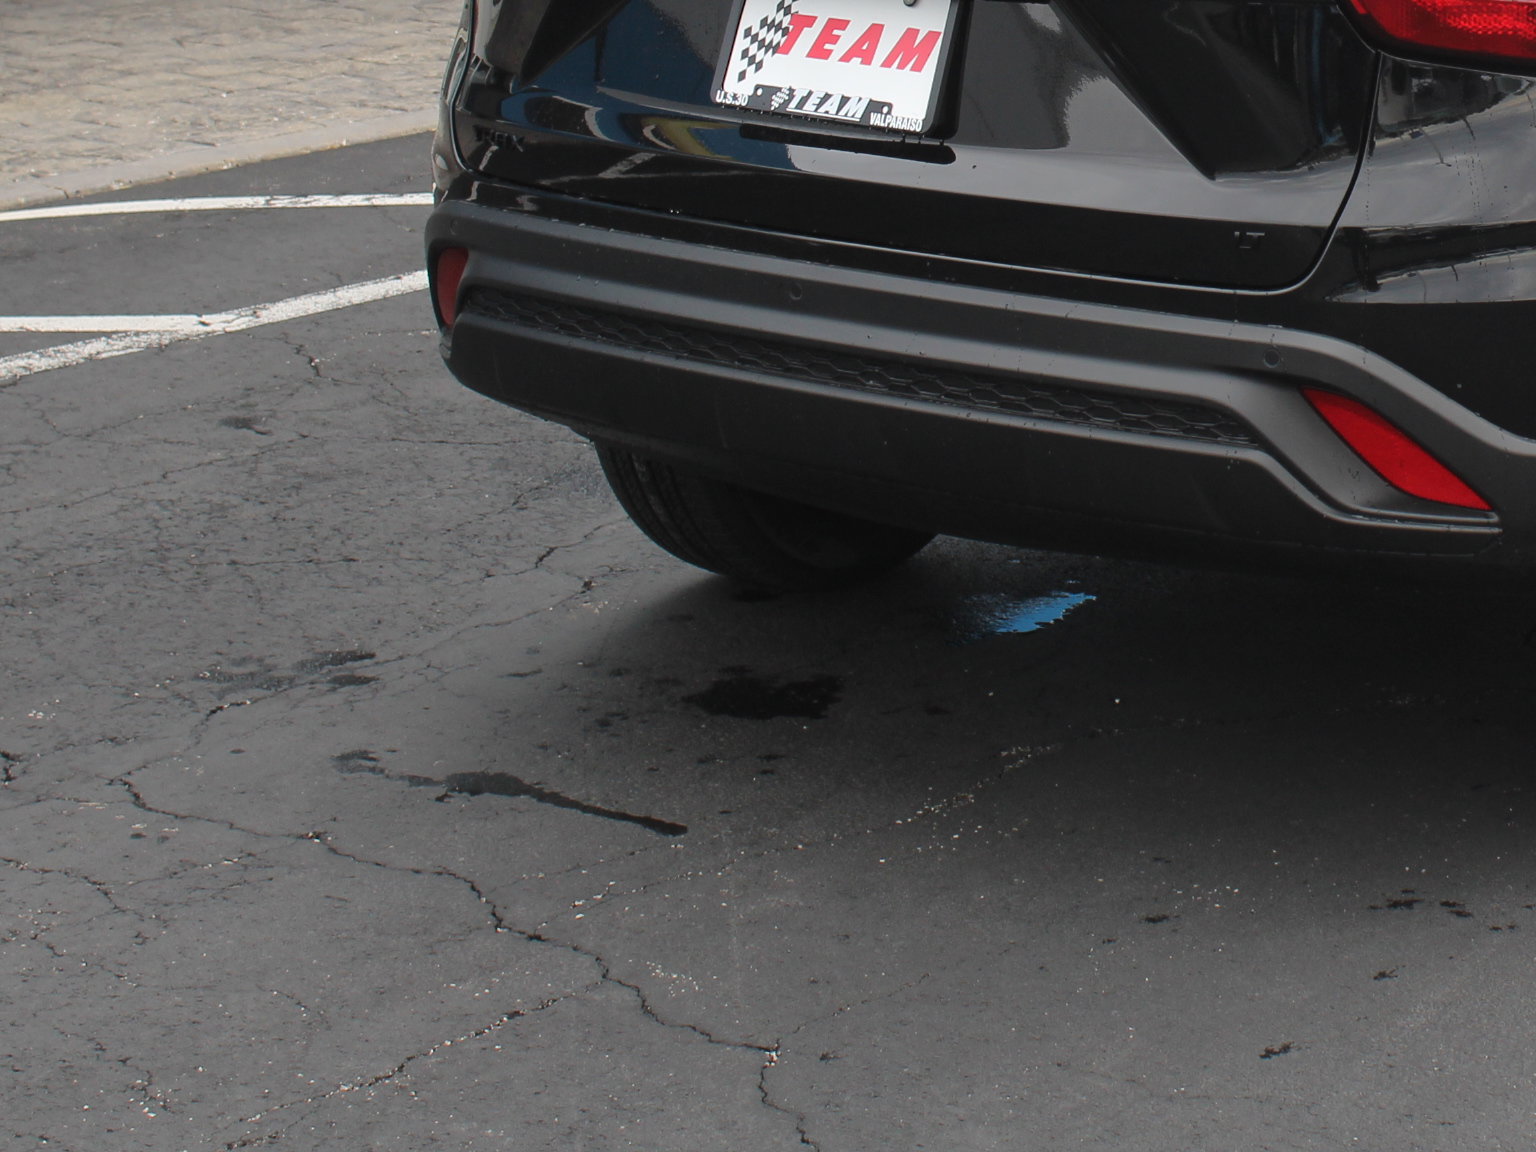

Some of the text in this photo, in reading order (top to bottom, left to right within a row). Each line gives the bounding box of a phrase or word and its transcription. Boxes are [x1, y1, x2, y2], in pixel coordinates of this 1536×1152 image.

[777, 13, 943, 73] TEAM
[786, 87, 871, 120] TEAM
[869, 112, 923, 132] VALPARAISO
